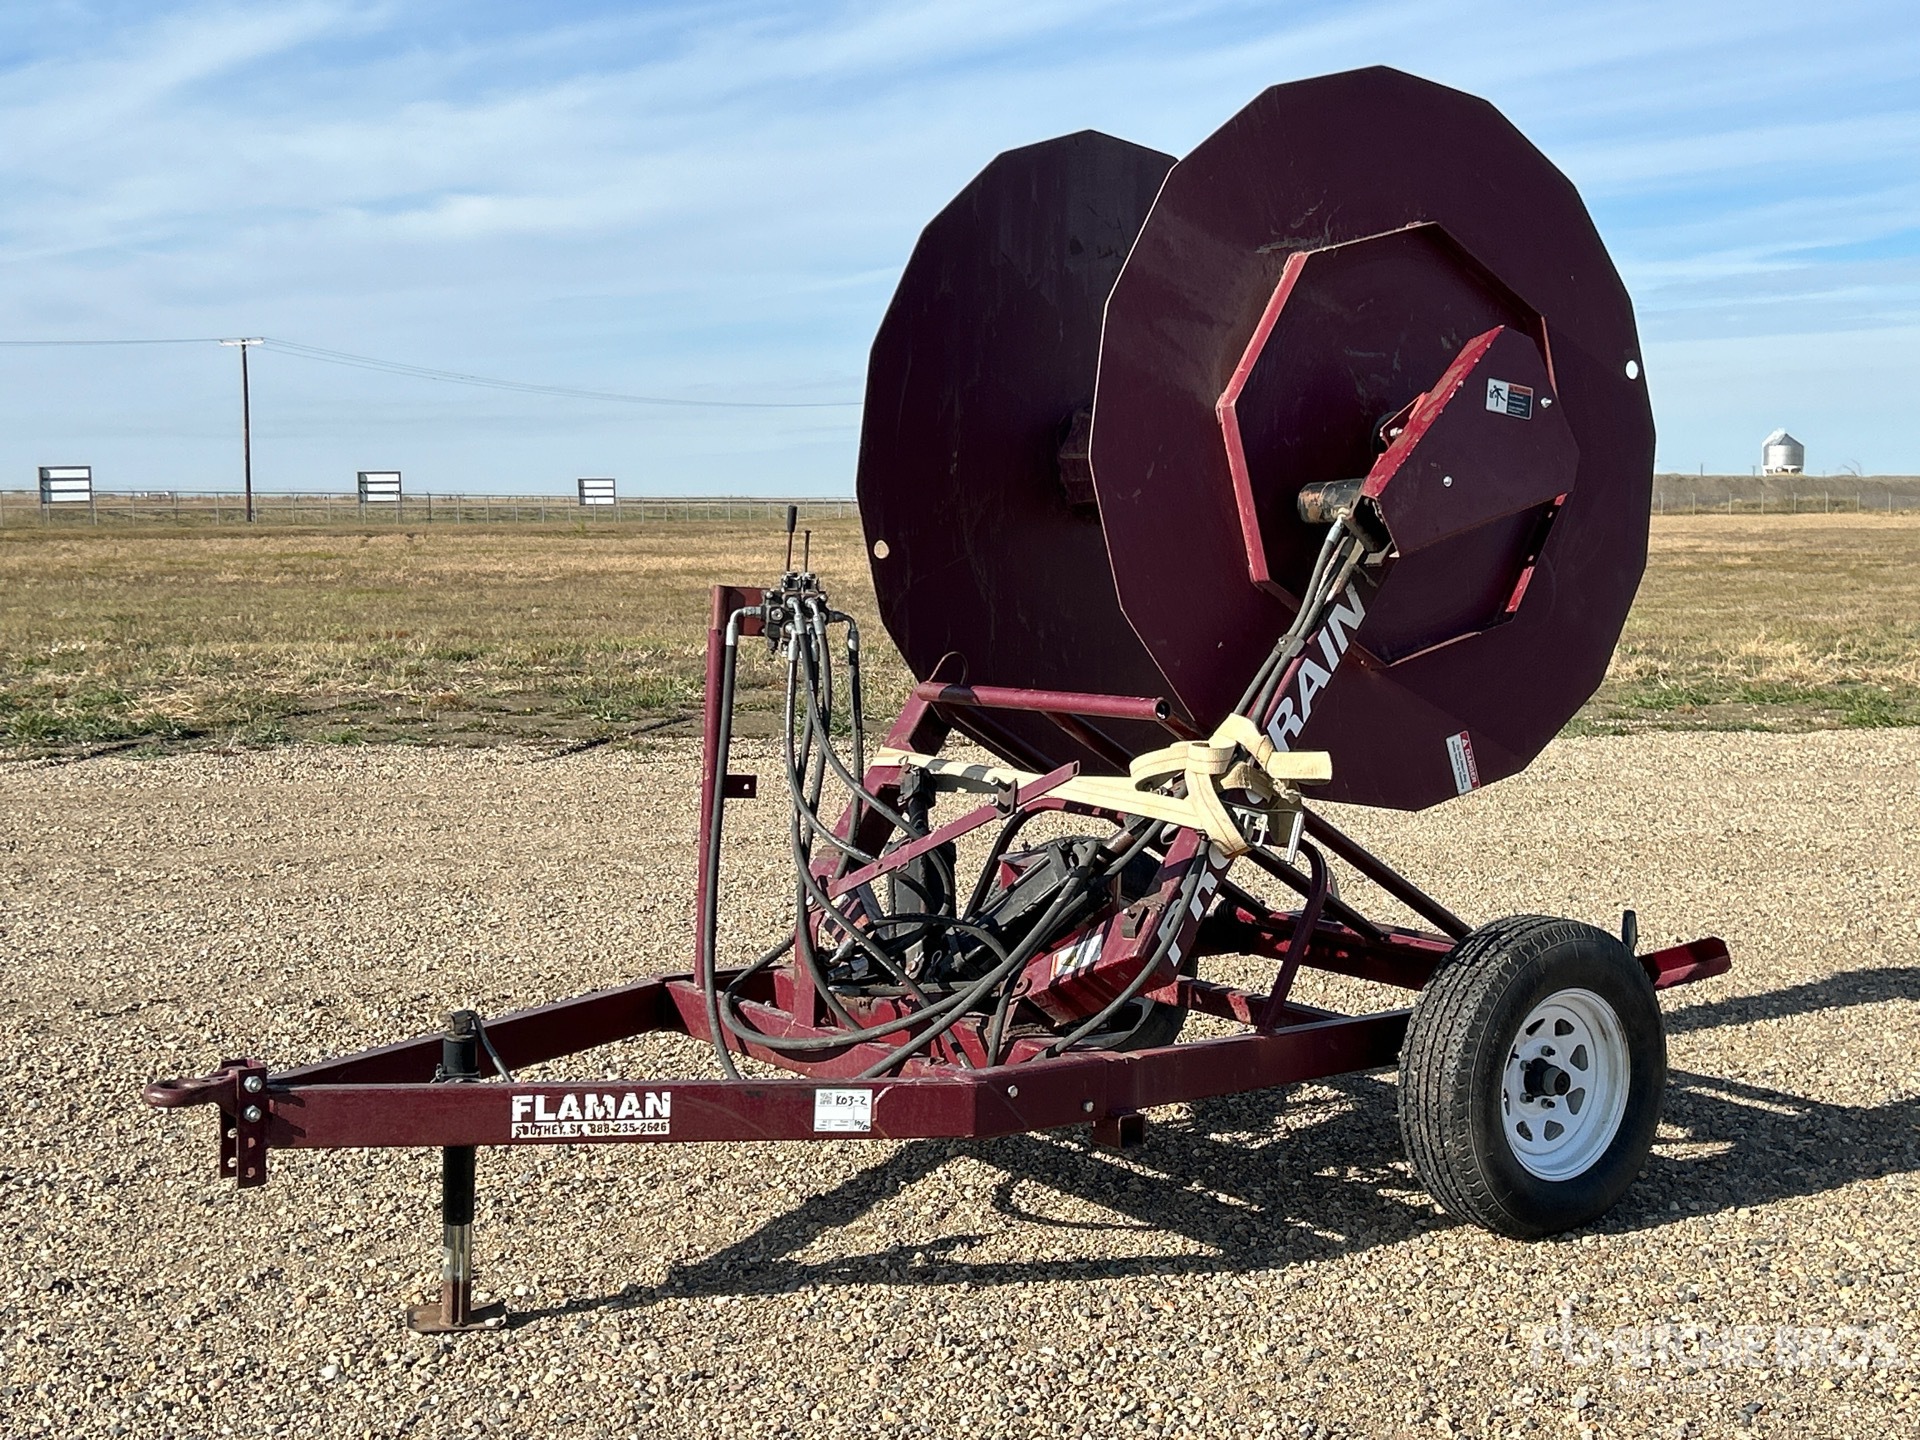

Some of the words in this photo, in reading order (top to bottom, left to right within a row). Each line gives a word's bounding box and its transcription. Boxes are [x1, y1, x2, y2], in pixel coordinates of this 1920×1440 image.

[1465, 749, 1477, 783] DANGER
[511, 1091, 671, 1121] FLAMAN
[589, 1122, 667, 1134] 888-235-2626
